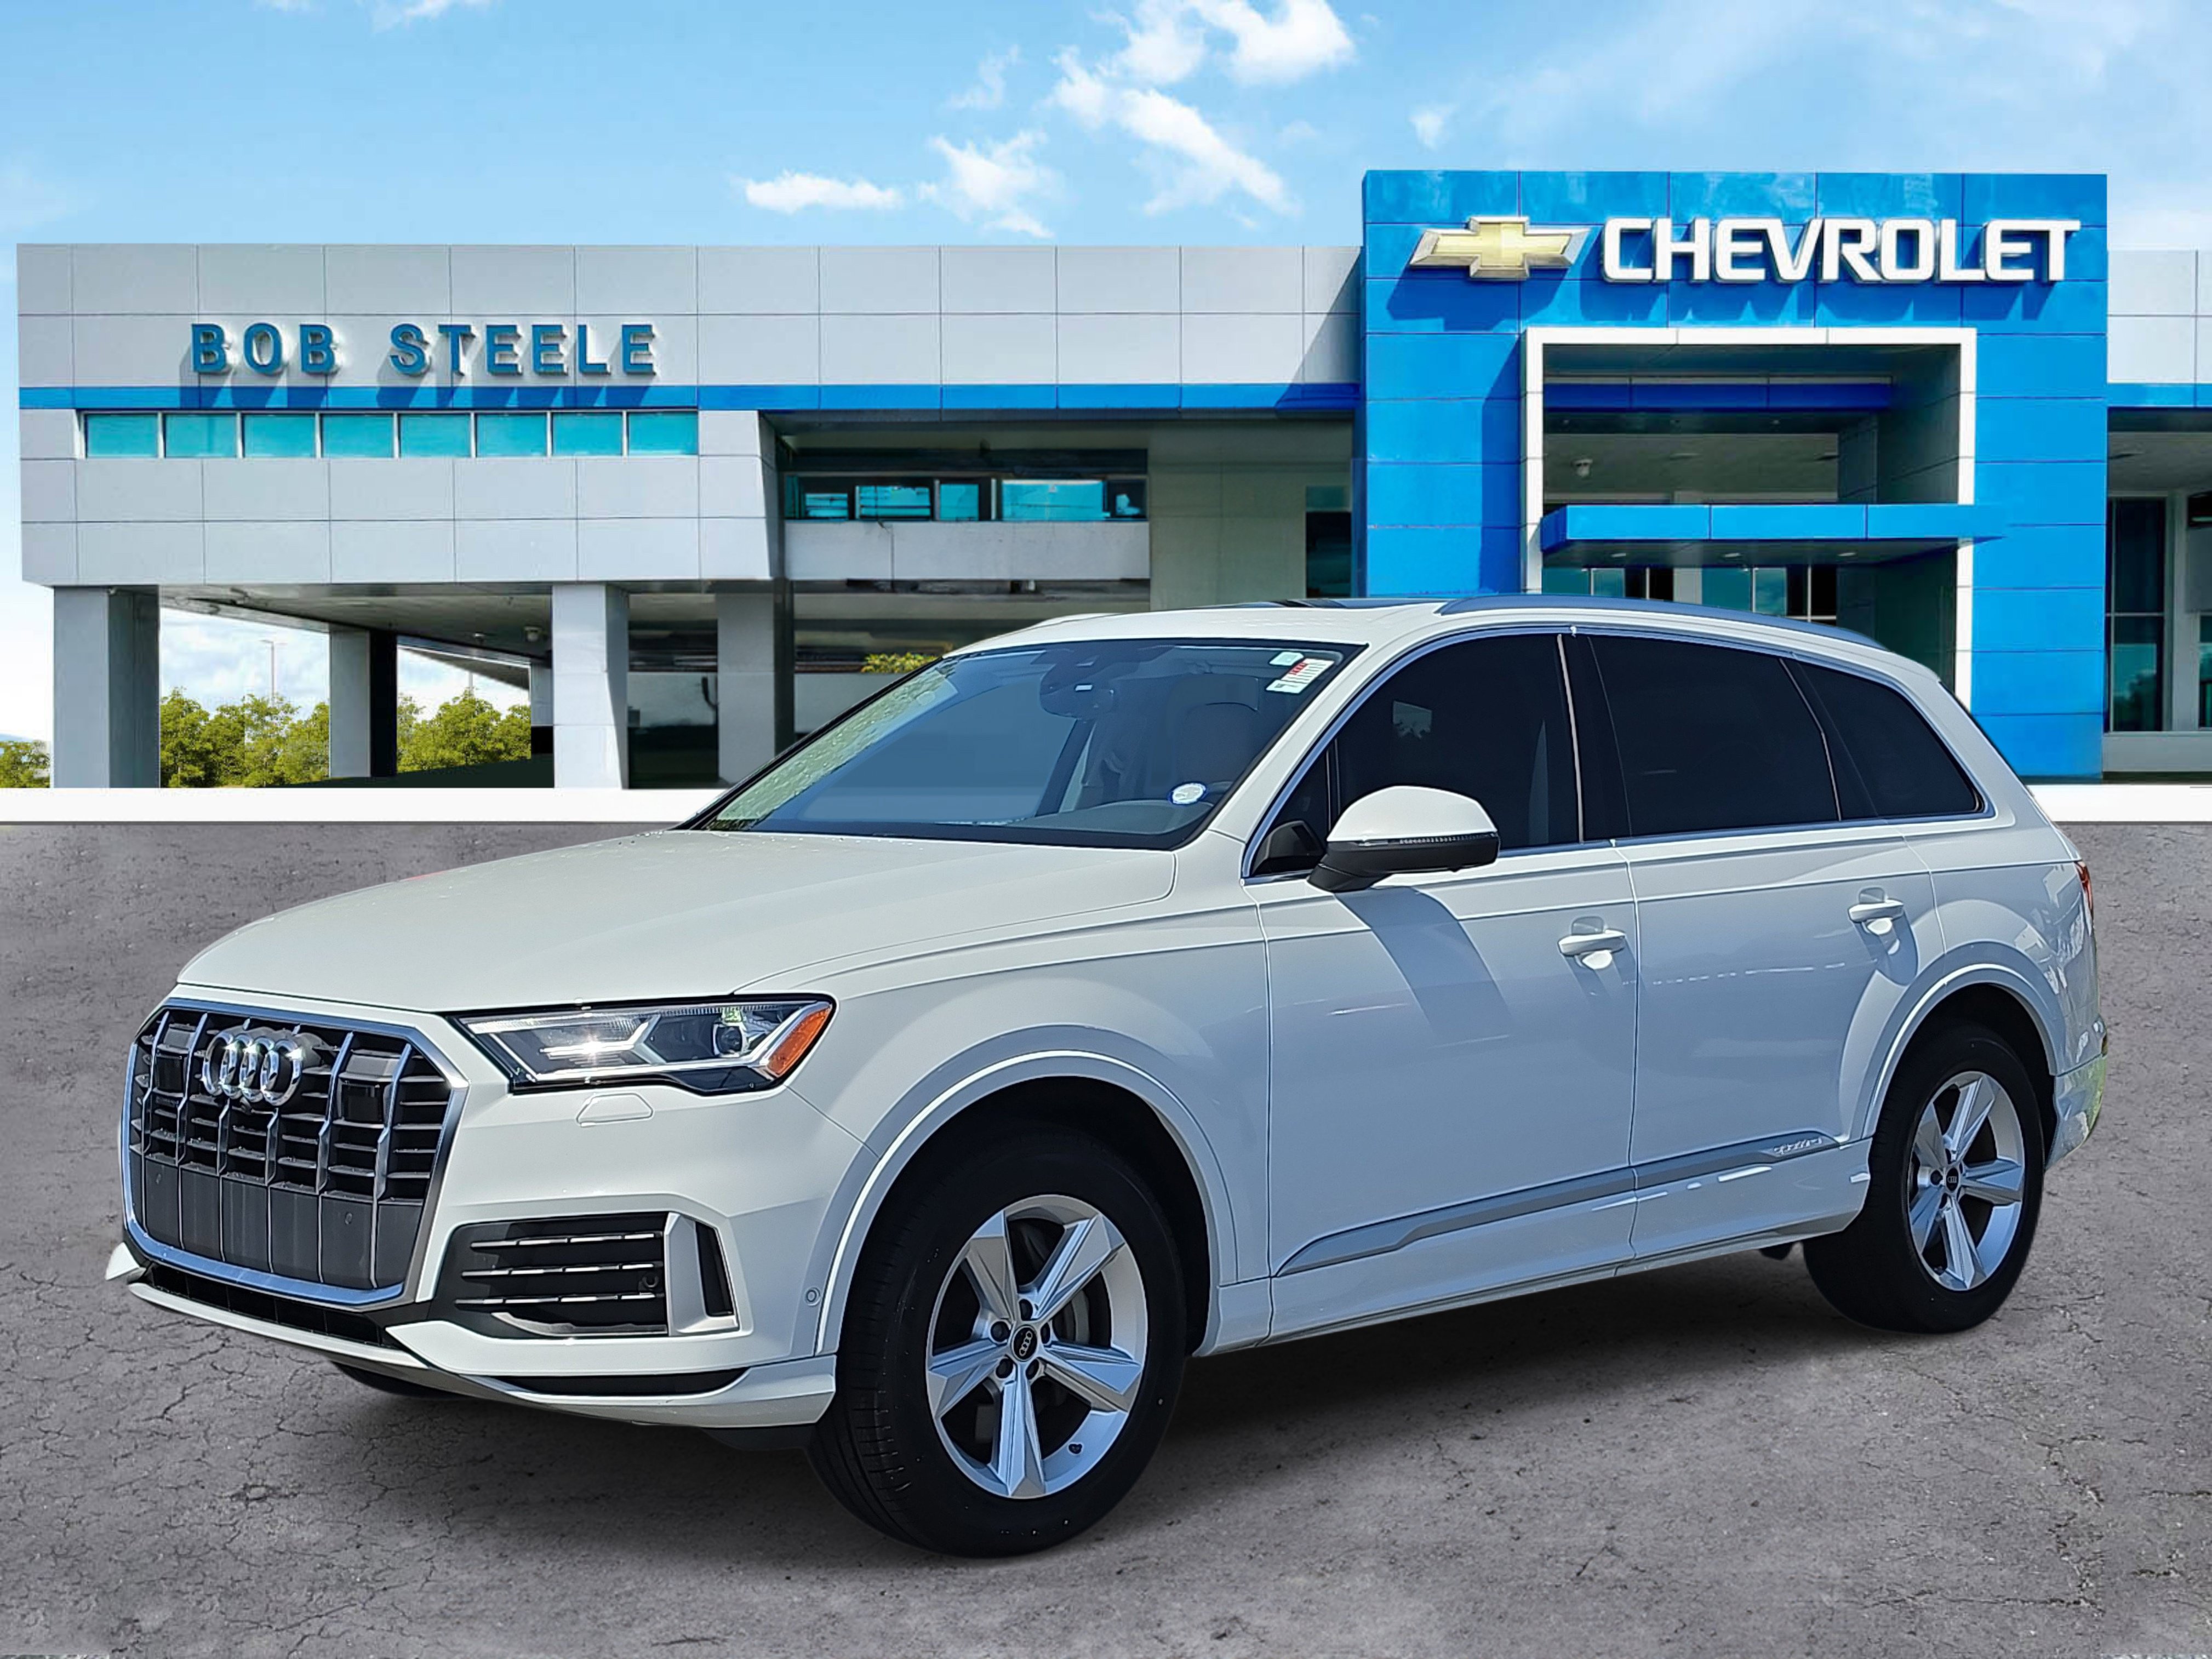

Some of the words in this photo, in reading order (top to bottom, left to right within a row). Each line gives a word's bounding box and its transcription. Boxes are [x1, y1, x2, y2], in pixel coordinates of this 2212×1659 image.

[1602, 218, 2082, 283] CHEVROLET
[191, 322, 339, 377] BOB
[388, 322, 658, 377] STEELE
